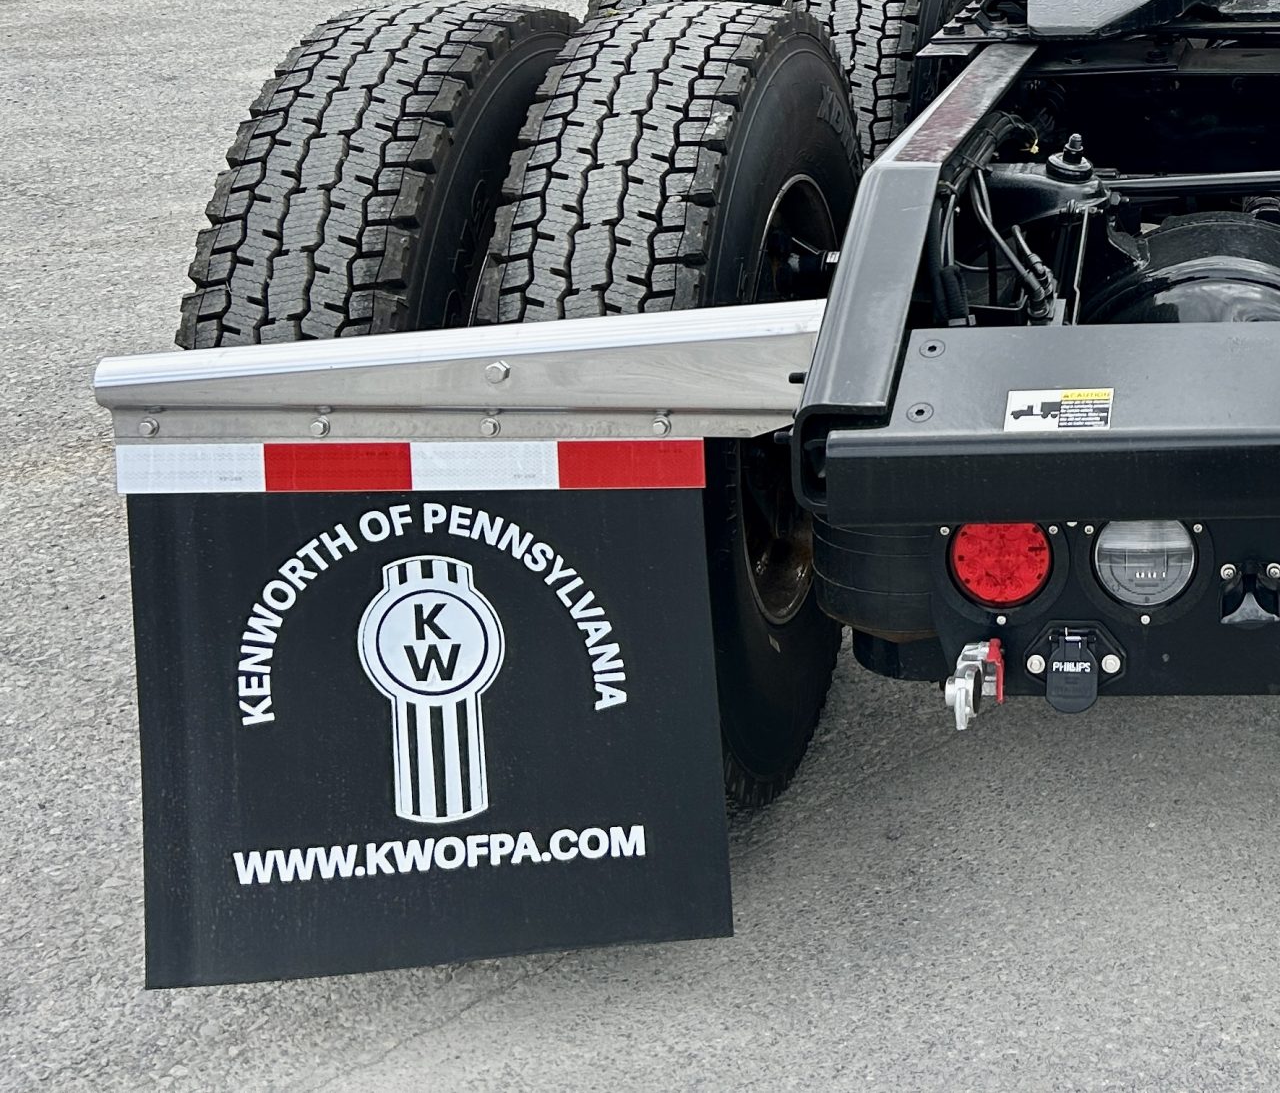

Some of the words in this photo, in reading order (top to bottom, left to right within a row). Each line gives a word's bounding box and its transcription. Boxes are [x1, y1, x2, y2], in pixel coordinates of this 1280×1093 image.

[238, 524, 358, 726] KENWORTH
[360, 505, 413, 542] OF
[424, 503, 628, 711] PENNSYLVANIA
[413, 603, 452, 641] K
[403, 644, 462, 682] W
[1052, 661, 1091, 673] PHILLIPS
[233, 826, 646, 885] WWW.KWOFPA.COM
